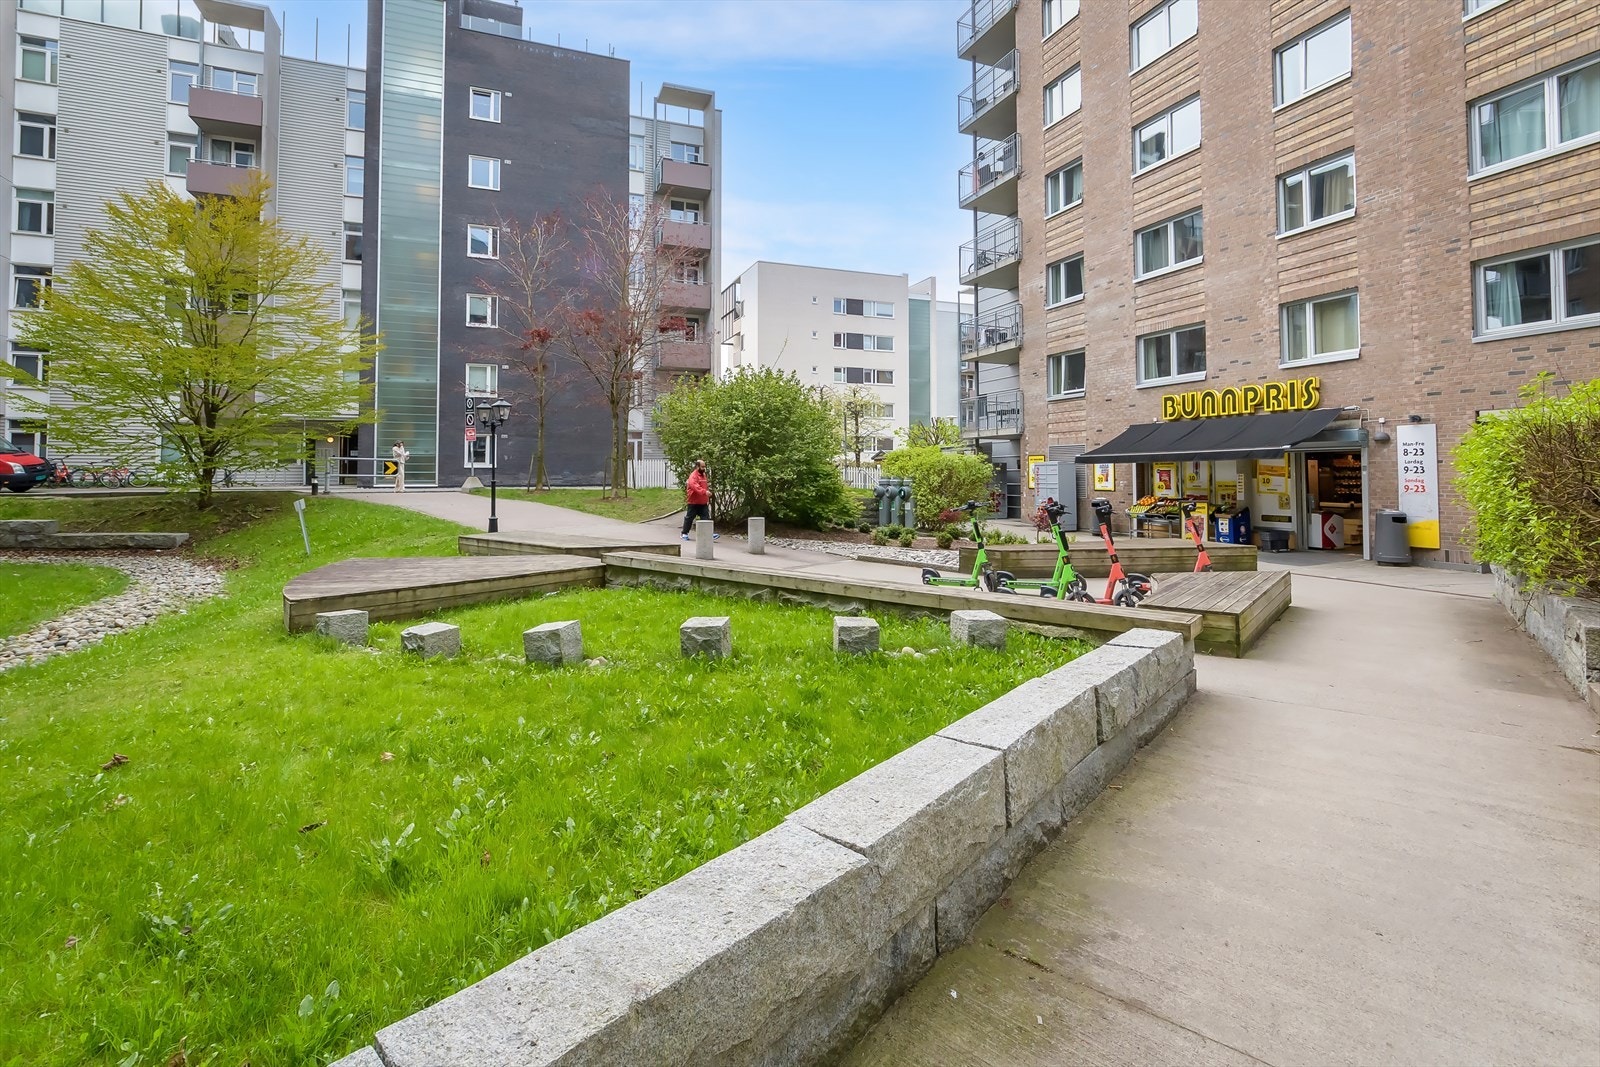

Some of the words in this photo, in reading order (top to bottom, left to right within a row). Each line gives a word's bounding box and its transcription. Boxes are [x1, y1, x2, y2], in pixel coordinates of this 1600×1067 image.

[1162, 376, 1321, 421] BUNNPRIS
[1403, 447, 1425, 457] 8-23
[1403, 465, 1426, 474] 9-23
[1403, 484, 1426, 493] 9-23
